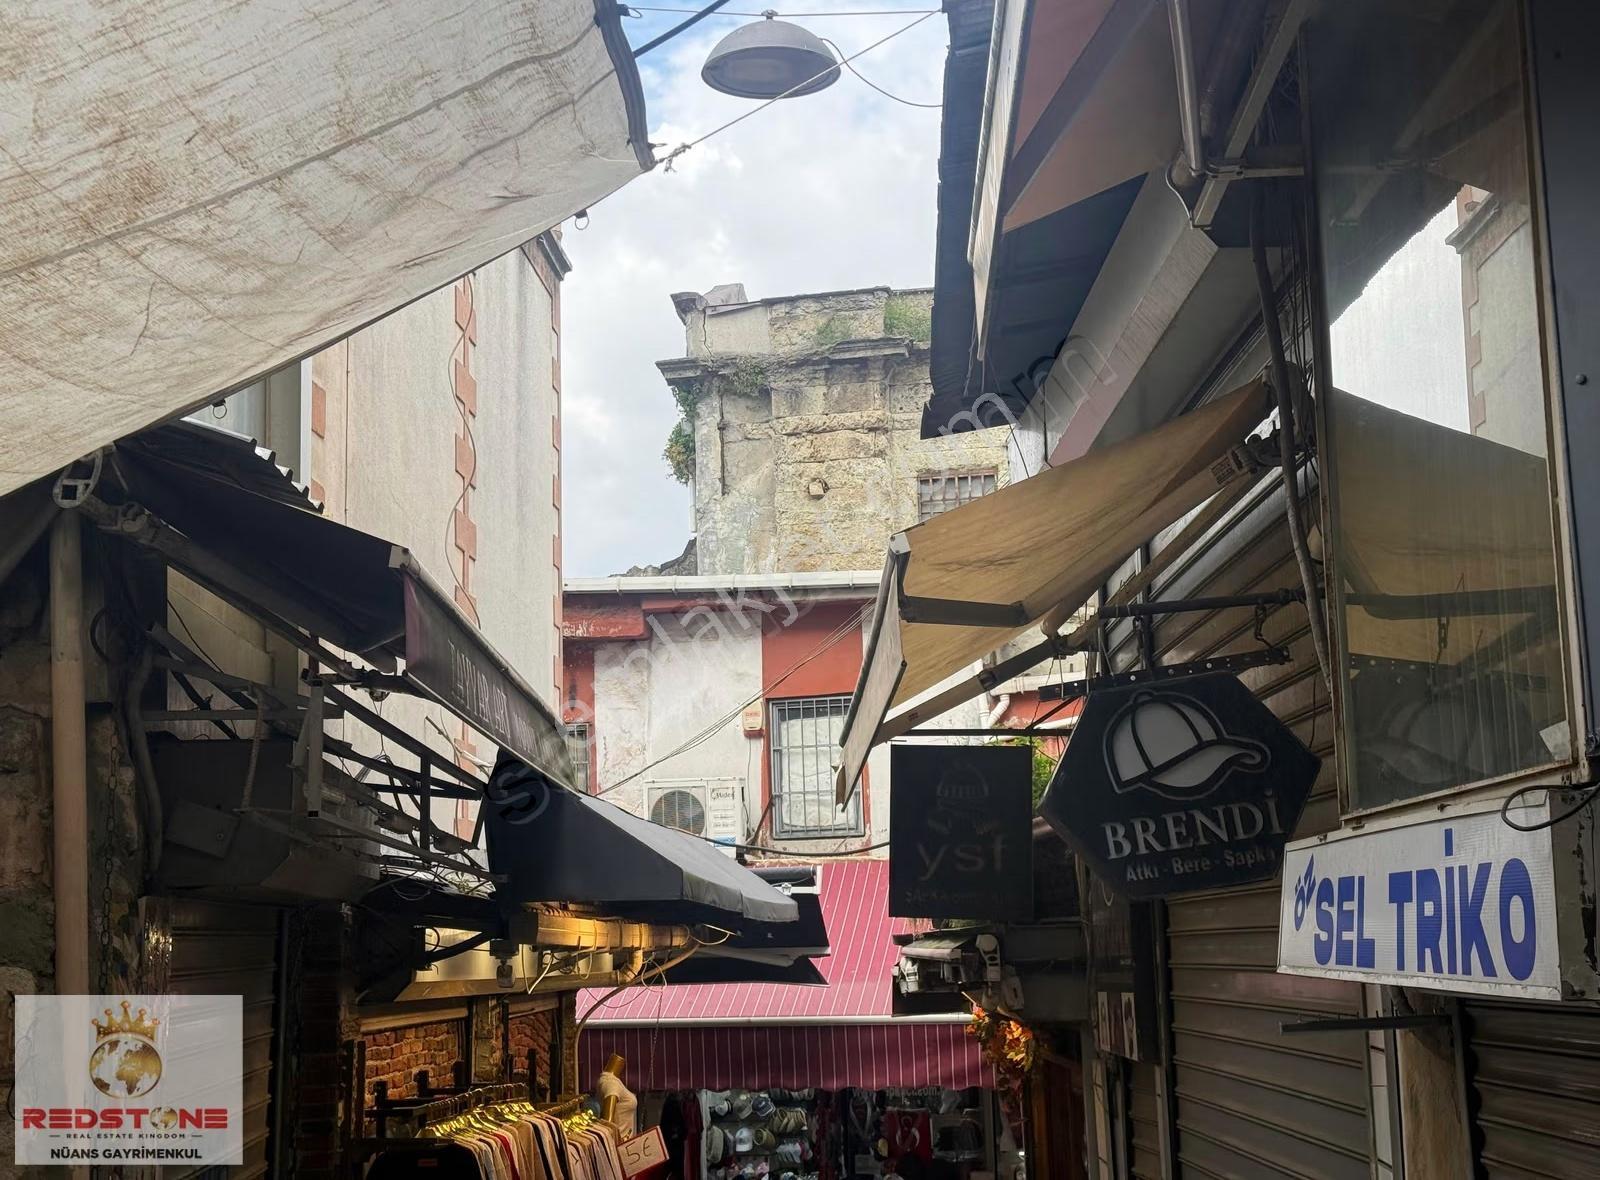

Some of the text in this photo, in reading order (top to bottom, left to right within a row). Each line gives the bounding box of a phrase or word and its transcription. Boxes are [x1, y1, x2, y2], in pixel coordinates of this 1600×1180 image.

[1101, 787, 1285, 861] BRENDİ
[1171, 855, 1212, 875] Bere
[1388, 828, 1537, 982] TRİKO
